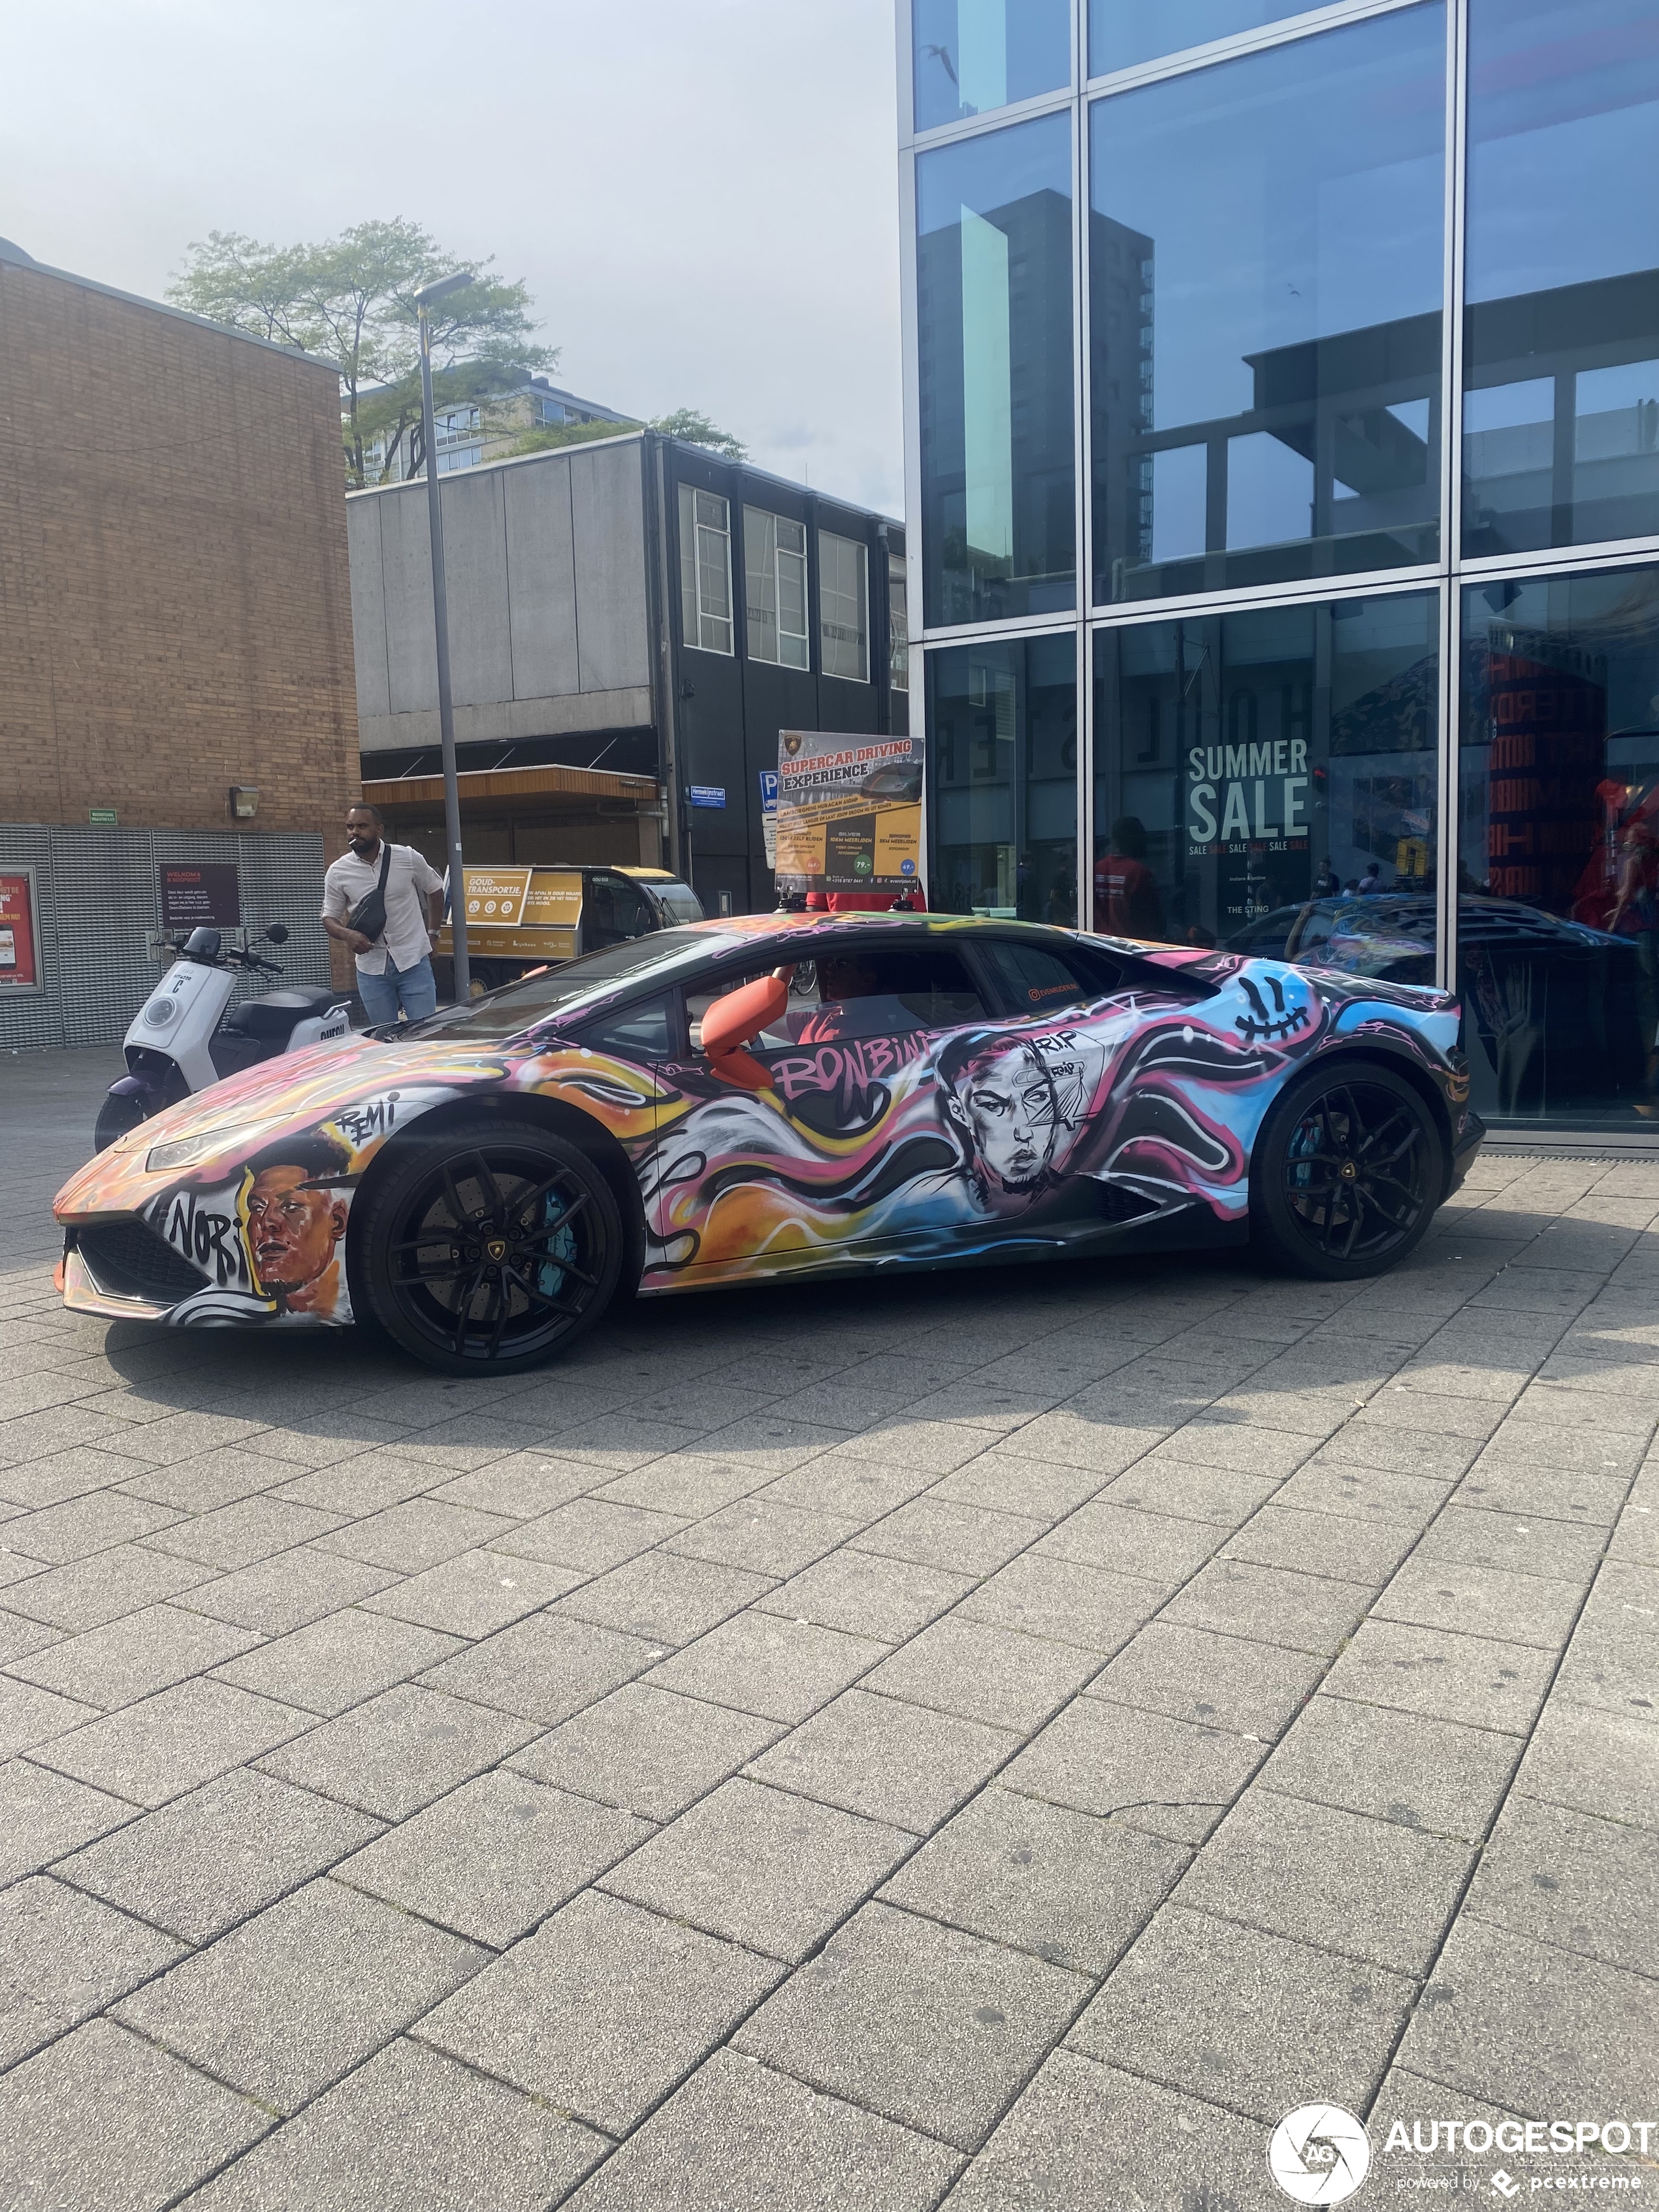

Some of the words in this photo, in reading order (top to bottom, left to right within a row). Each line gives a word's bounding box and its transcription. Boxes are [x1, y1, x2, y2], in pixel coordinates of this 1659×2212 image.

[781, 751, 855, 776] SUPERCAR
[857, 739, 912, 762] DRIVING
[1189, 739, 1308, 782] SUMMER
[765, 775, 777, 795] P
[783, 762, 869, 791] EXPERIENCE
[780, 805, 816, 817] LAMBORGHINI
[818, 801, 842, 809] HURACAN
[1189, 777, 1308, 842] SALE
[1189, 846, 1207, 856] SALE
[1209, 844, 1227, 854] SALE
[1229, 843, 1247, 854] SALE
[1269, 841, 1287, 851] SALE
[1290, 840, 1308, 850] SALE
[468, 886, 521, 894] TRANSPORTJE.
[172, 980, 184, 993] C
